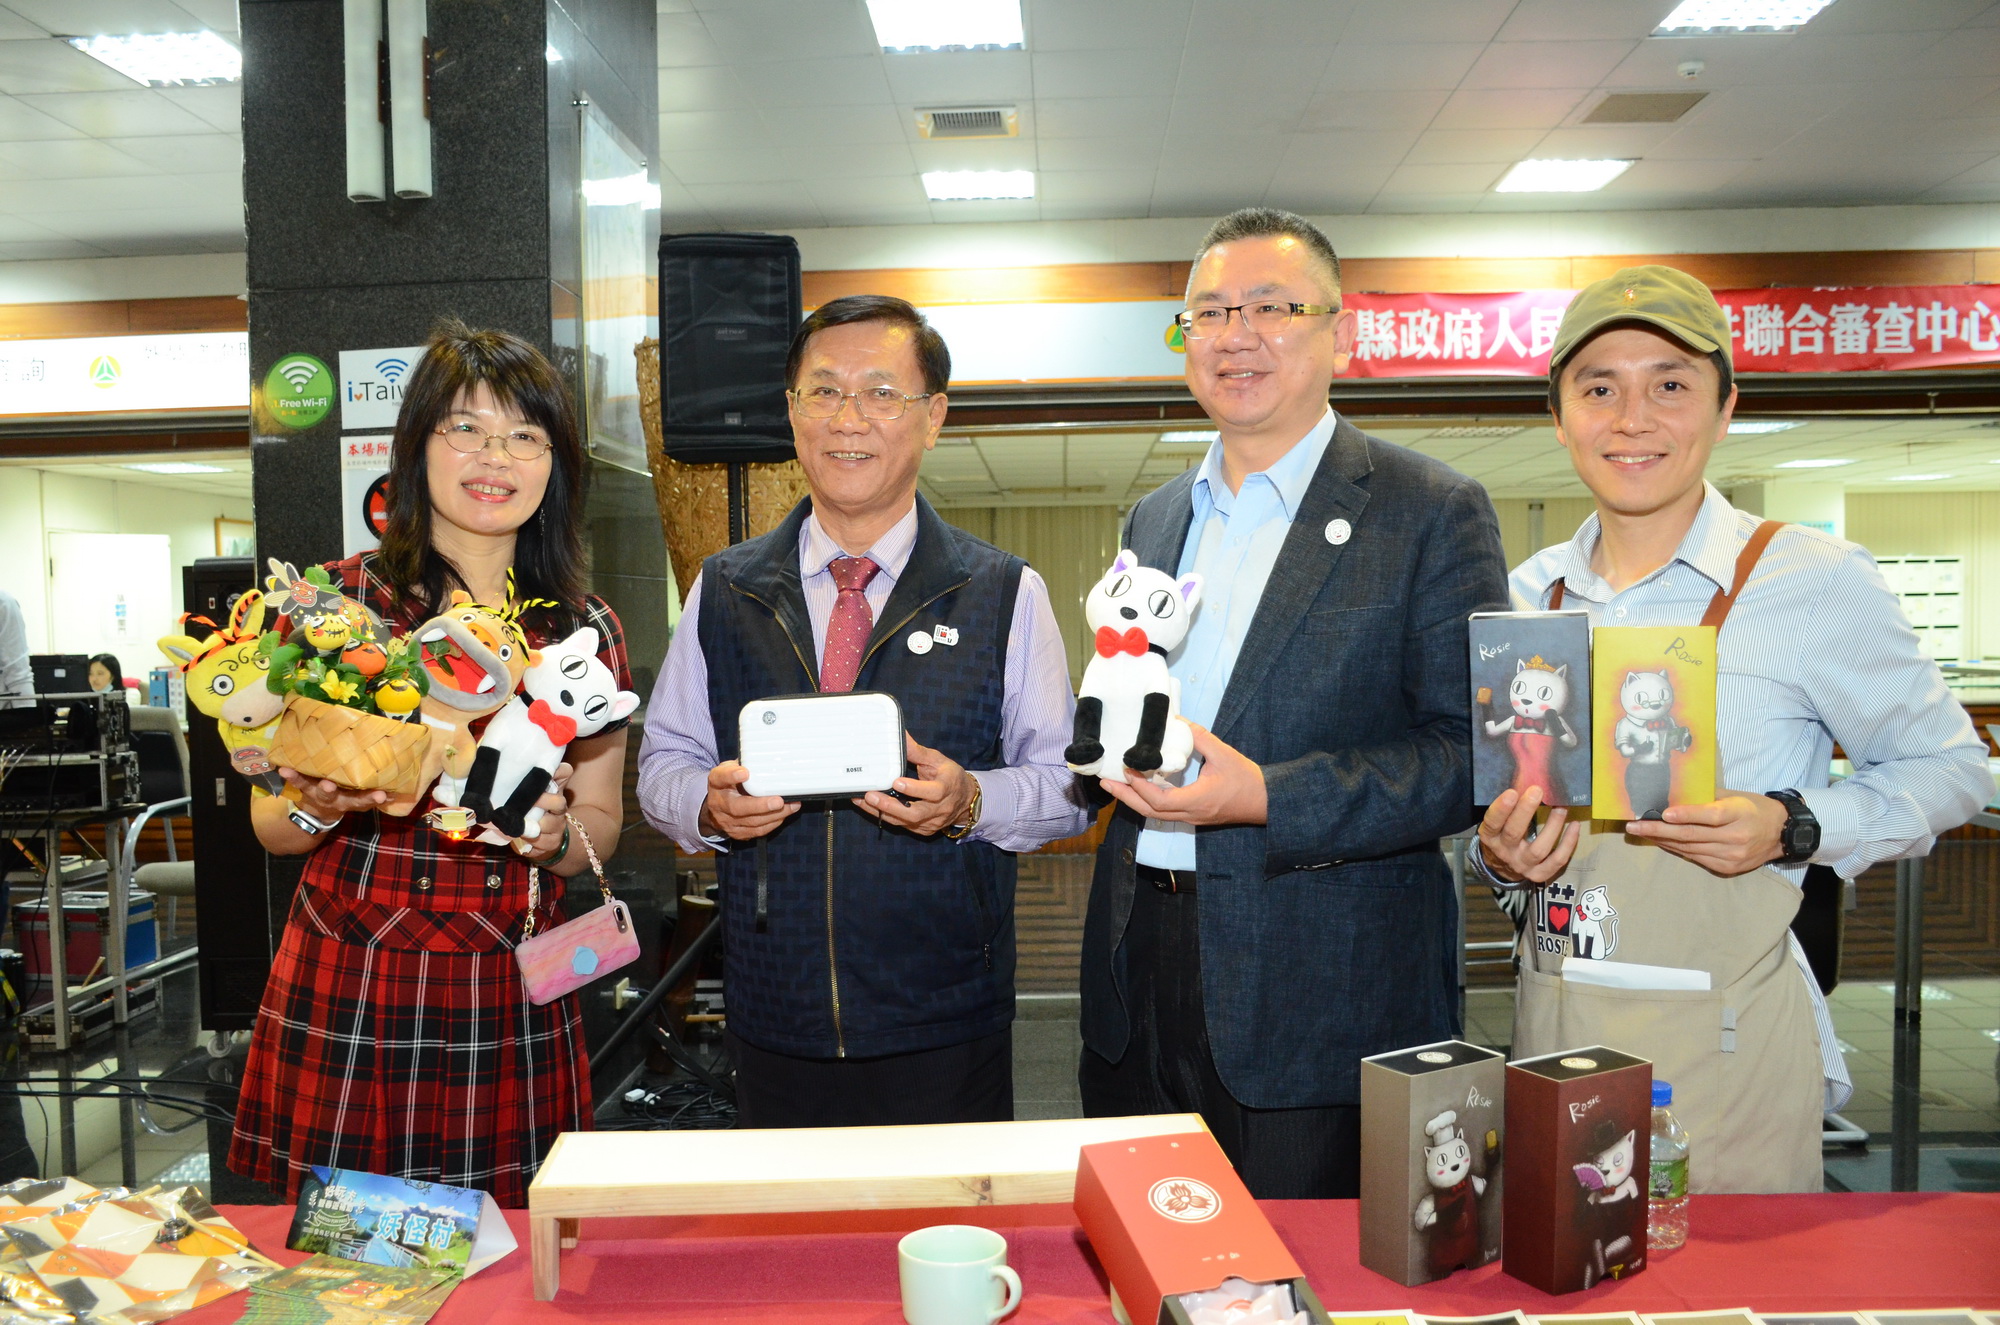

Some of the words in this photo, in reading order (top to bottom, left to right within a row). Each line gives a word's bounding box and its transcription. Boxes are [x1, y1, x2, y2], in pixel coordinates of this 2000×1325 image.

[302, 397, 327, 407] Wi-Fi
[348, 443, 389, 456] 本場所
[1479, 641, 1511, 661] Rosie
[1664, 636, 1703, 667] Rosie
[1568, 1094, 1600, 1124] Rosie
[376, 1210, 457, 1250] 妖怪村
